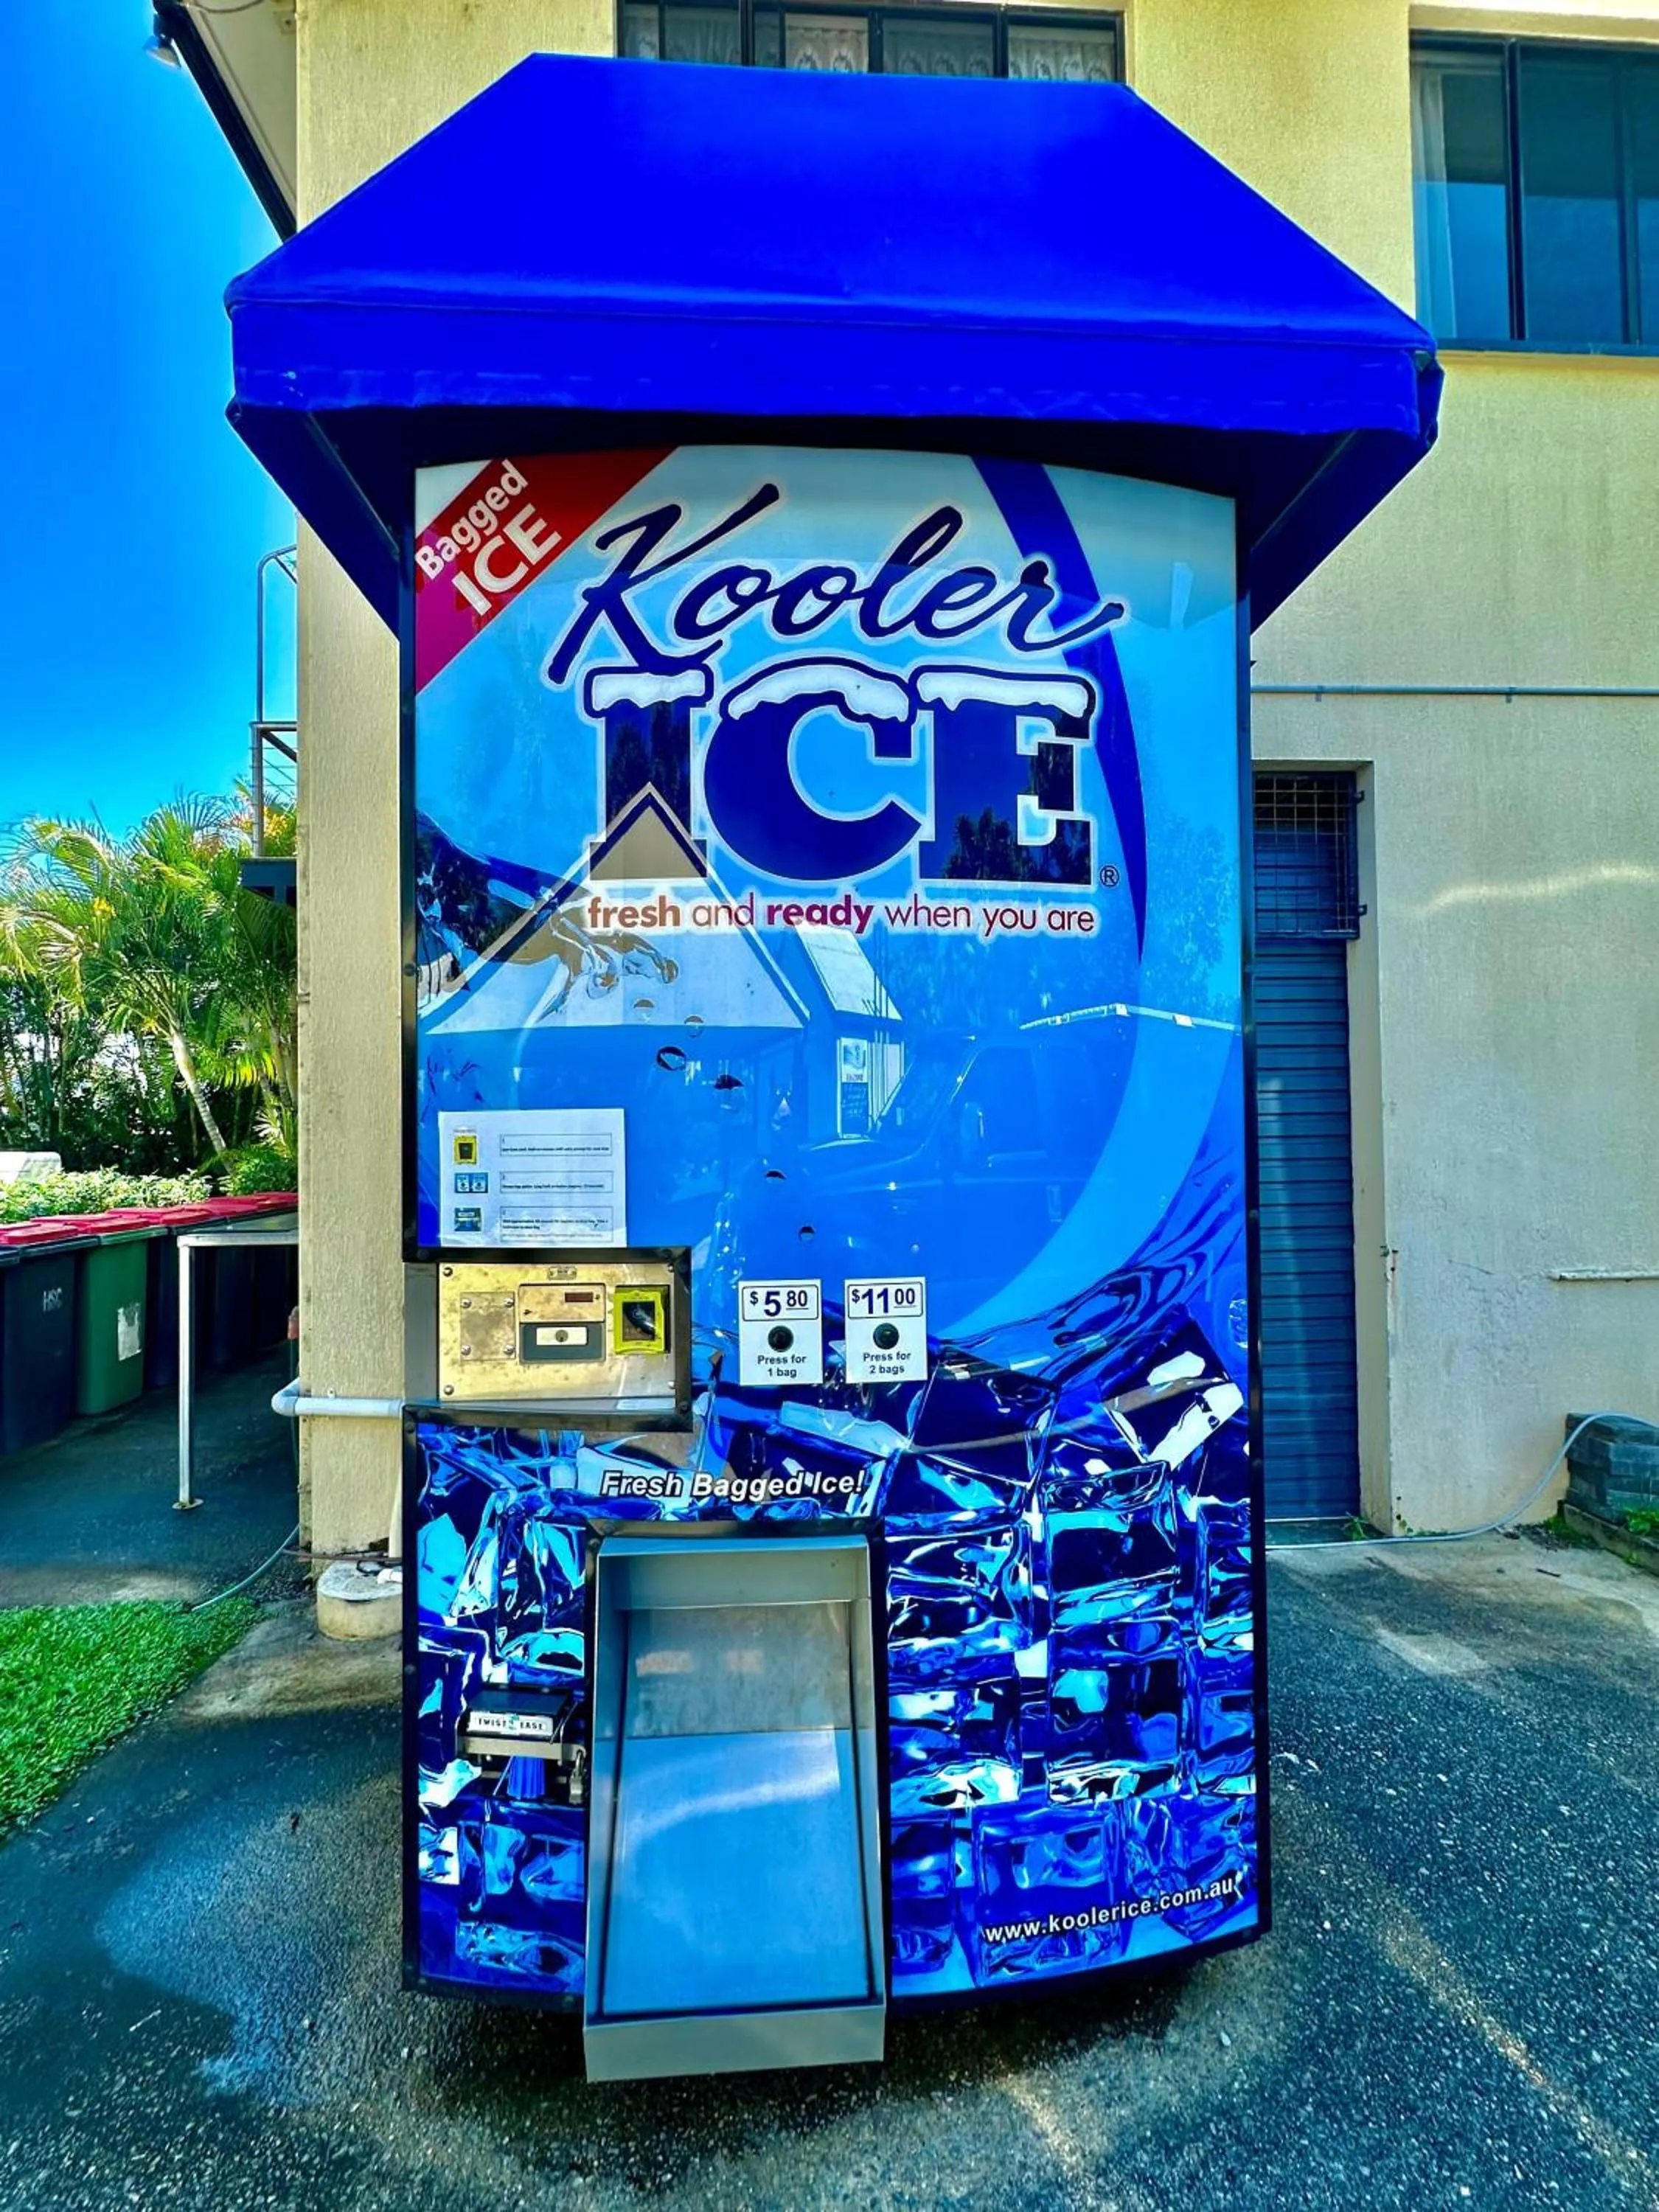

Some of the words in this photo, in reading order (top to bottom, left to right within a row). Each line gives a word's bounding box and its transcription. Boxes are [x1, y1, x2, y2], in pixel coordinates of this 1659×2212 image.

[414, 459, 529, 580] Bagged
[451, 503, 563, 616] ICE
[548, 483, 1124, 685] Kooler
[584, 656, 1096, 886] ICE
[588, 894, 681, 928] fresh
[692, 891, 754, 927] and
[766, 894, 875, 934] ready
[884, 893, 971, 928] when
[982, 907, 1037, 937] you
[1047, 908, 1095, 932] are
[757, 1354, 788, 1365] Press
[791, 1354, 807, 1364] for
[768, 1368, 773, 1377] 1
[776, 1367, 797, 1378] bag
[863, 1352, 894, 1363] Press
[896, 1352, 911, 1361] for
[869, 1365, 876, 1374] 2
[878, 1364, 905, 1375] bags
[601, 1470, 683, 1496] Fresh
[692, 1471, 804, 1502] Bagged
[811, 1470, 866, 1495] Ice!
[984, 1877, 1234, 1943] www.koolerice.com.au
